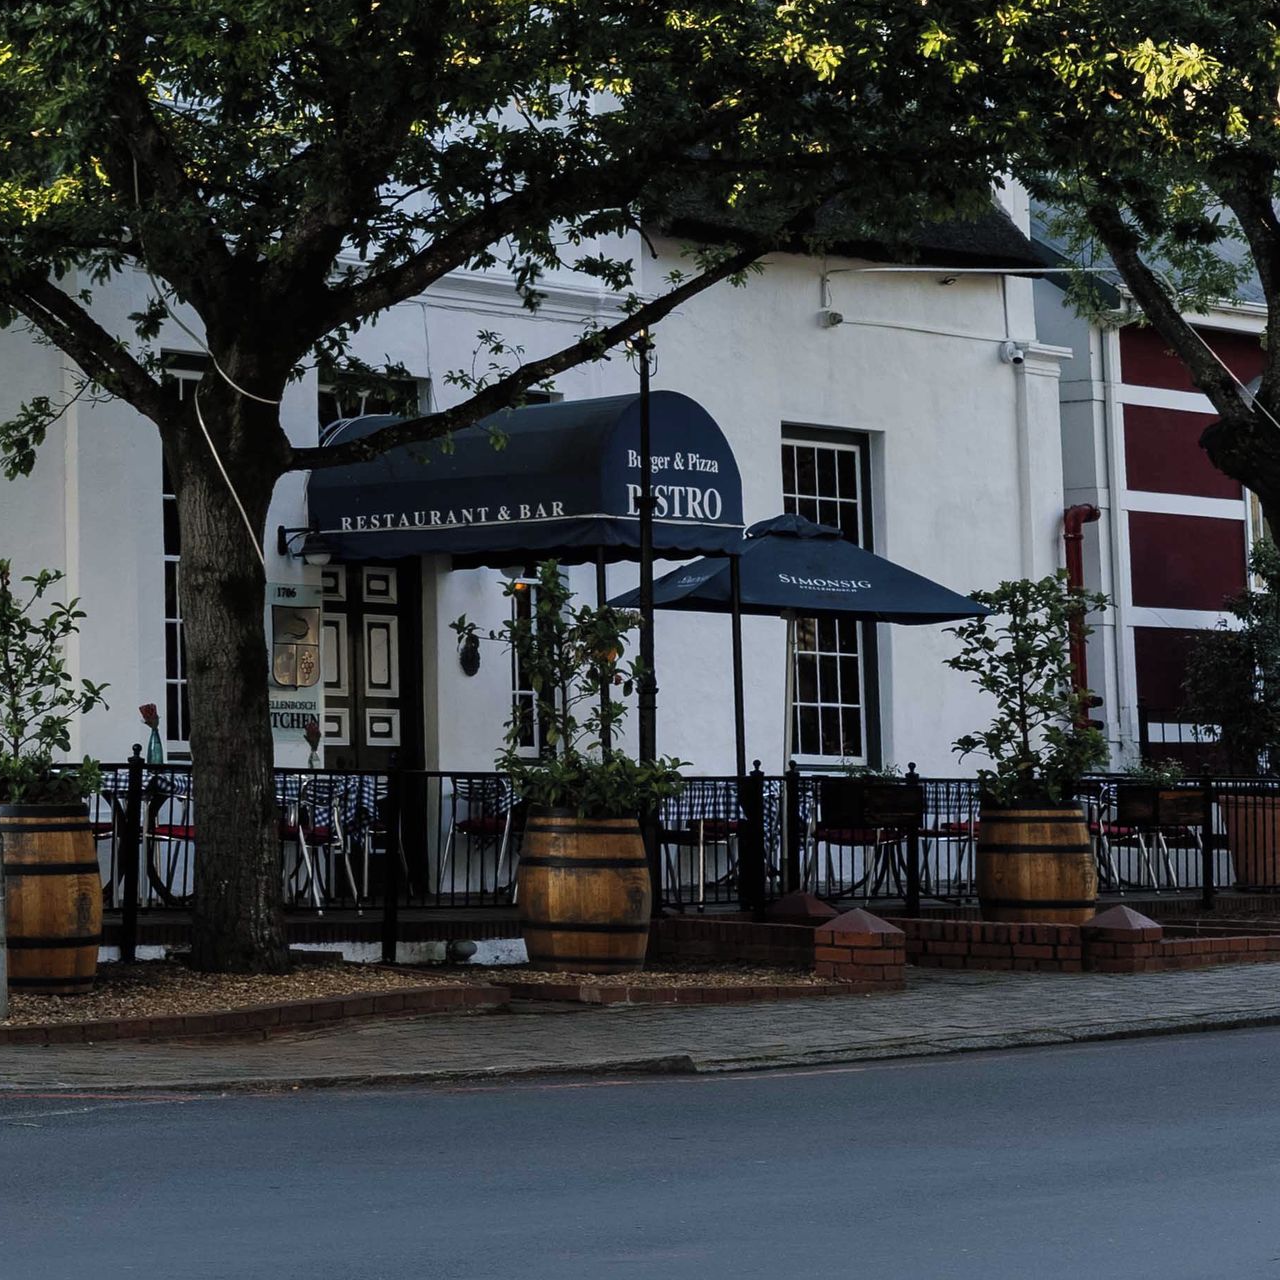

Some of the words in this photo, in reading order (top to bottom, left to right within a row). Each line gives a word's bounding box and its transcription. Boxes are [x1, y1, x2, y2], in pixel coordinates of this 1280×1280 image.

[673, 451, 685, 471] &
[687, 452, 719, 473] Pizza
[625, 483, 723, 520] BSTRO
[341, 506, 489, 531] RESTAURANT
[497, 505, 511, 521] &
[519, 501, 565, 519] BAR
[778, 573, 872, 589] SIMONSIG
[271, 711, 320, 729] TCHEN
